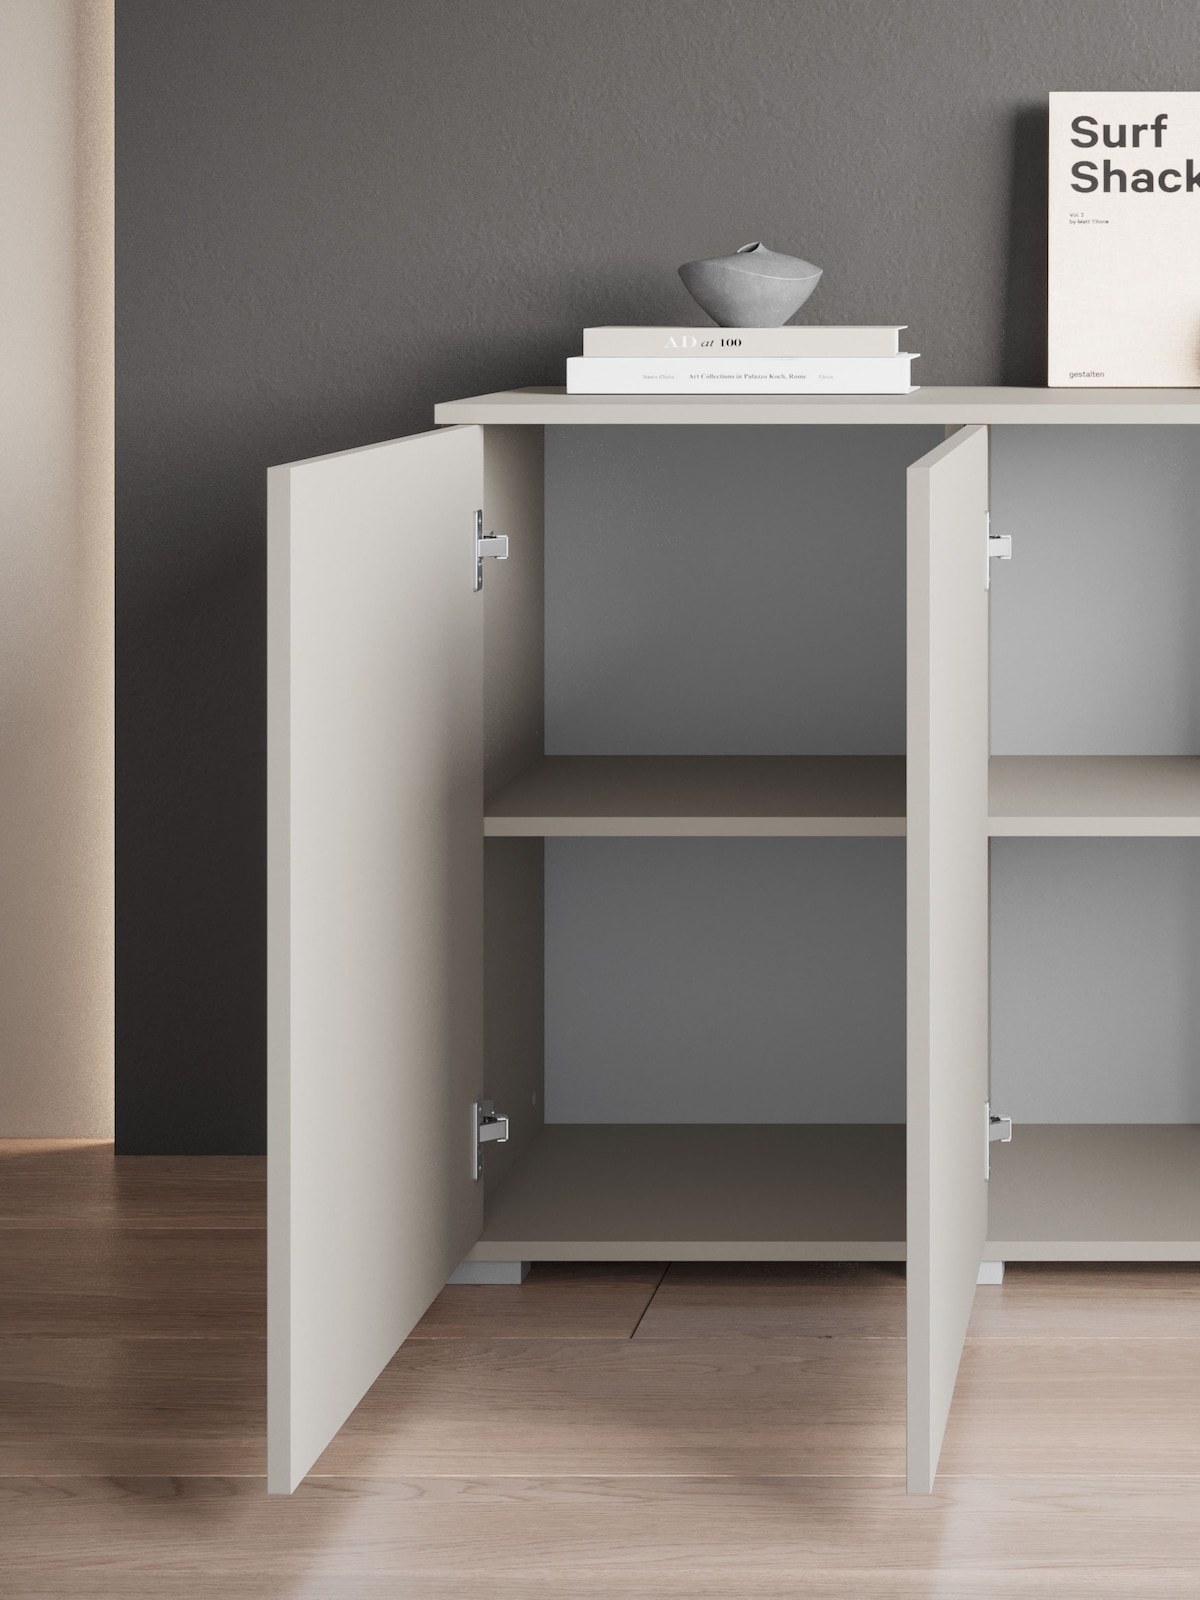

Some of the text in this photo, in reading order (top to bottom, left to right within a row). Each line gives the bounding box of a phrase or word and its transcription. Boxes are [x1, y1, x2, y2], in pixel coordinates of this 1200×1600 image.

[1071, 114, 1168, 148] Surf
[664, 336, 697, 348] AD
[720, 339, 742, 347] 100
[1069, 370, 1105, 379] gestalten
